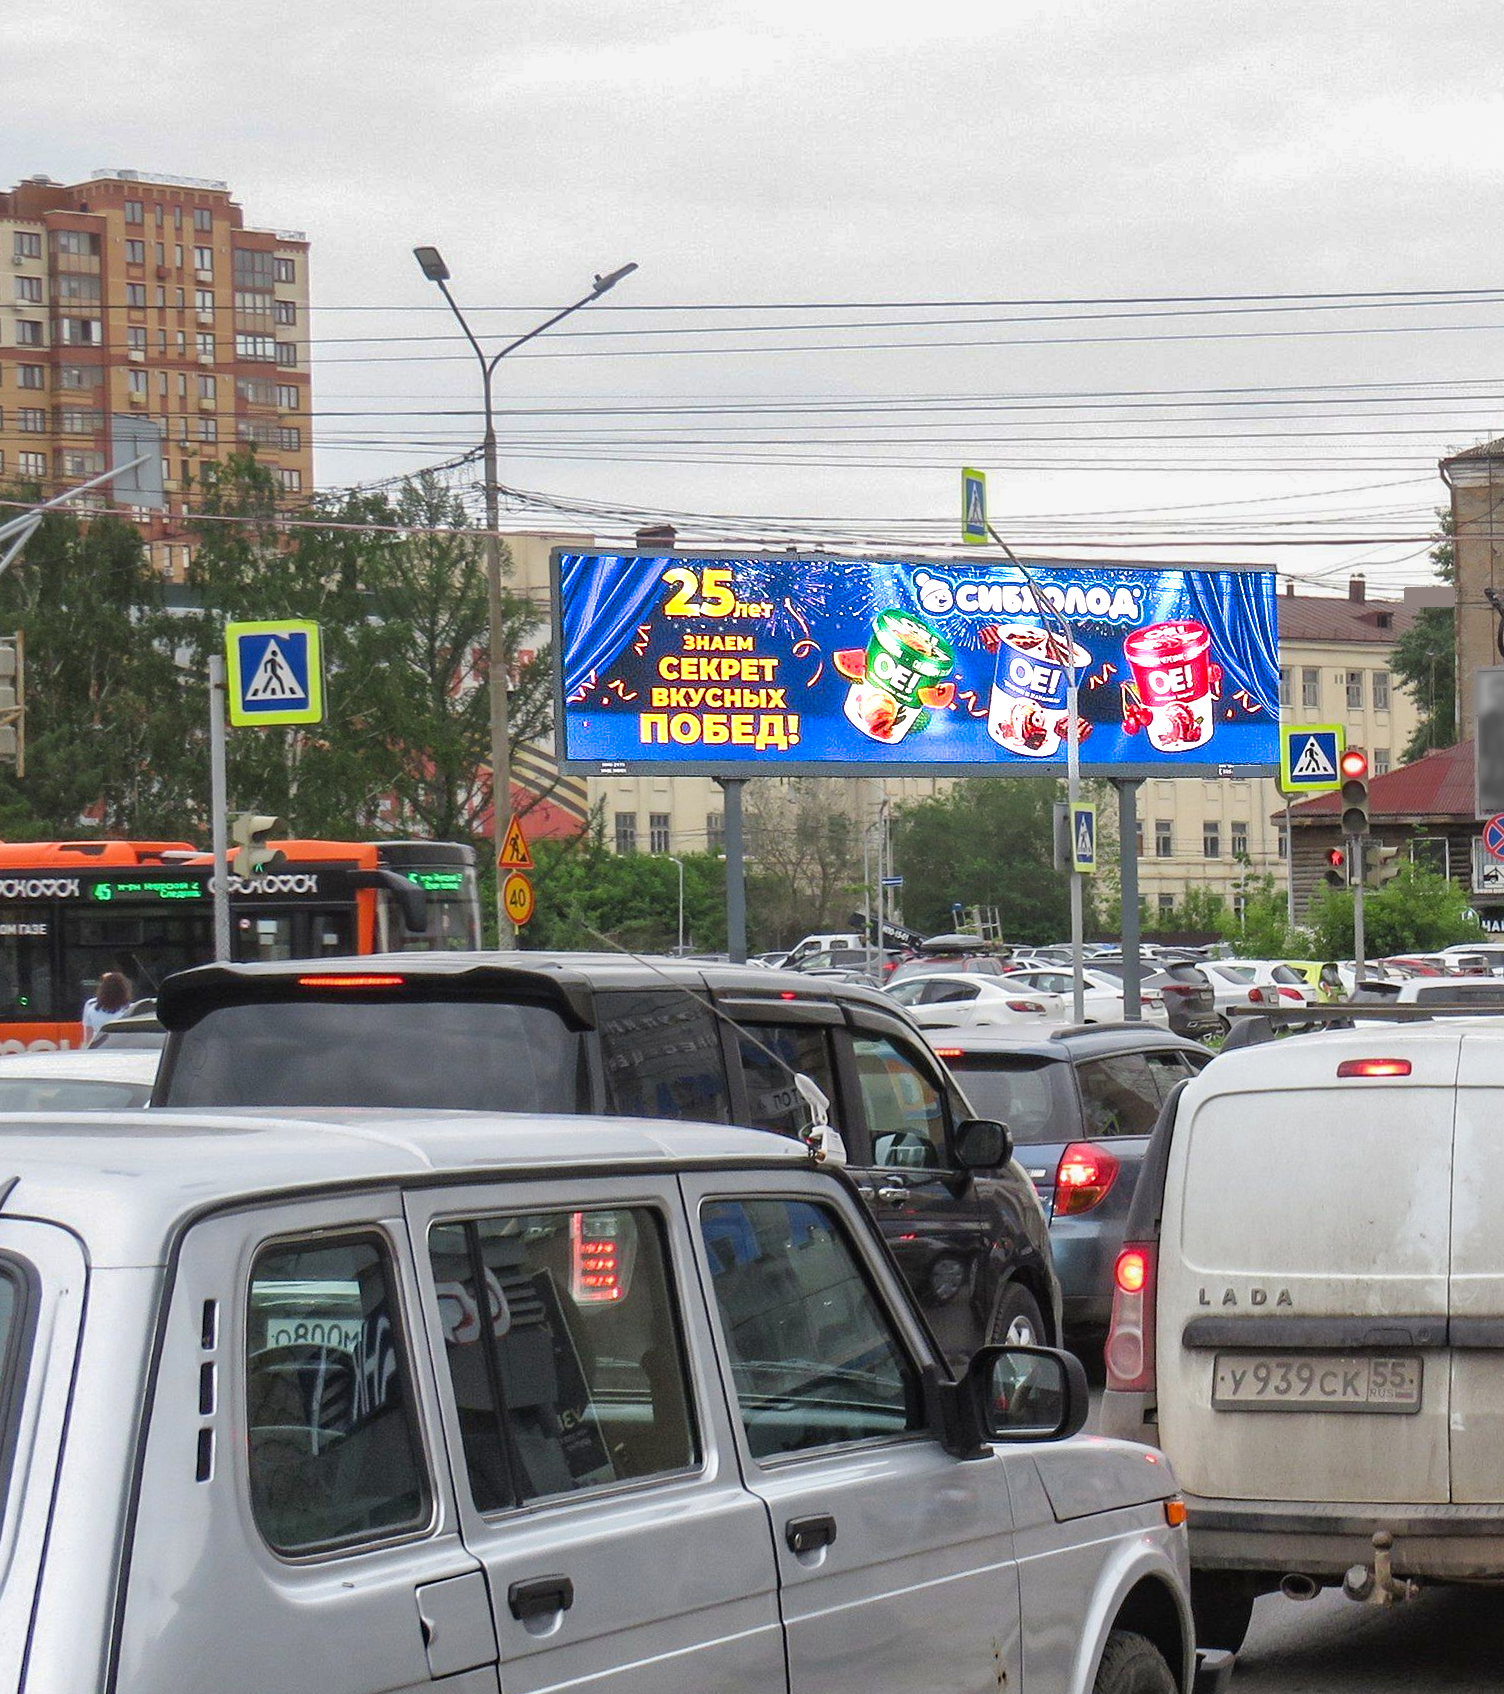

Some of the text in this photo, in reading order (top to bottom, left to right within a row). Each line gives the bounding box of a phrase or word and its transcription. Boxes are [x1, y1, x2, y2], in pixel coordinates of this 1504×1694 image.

[662, 567, 774, 619] 25 лет
[955, 583, 1139, 620] СИБХОЛОД
[682, 634, 754, 651] ЗНАЕМ
[658, 656, 779, 682] СЕКРЕТ
[651, 687, 787, 709] ВКУСНЫХ
[640, 712, 800, 751] ПОБЕД!
[510, 888, 526, 908] 40
[18, 924, 47, 935] ГАЗЕ
[1199, 1287, 1293, 1306] LADA
[1372, 1361, 1406, 1388] 55
[1369, 1388, 1394, 1399] RUS
